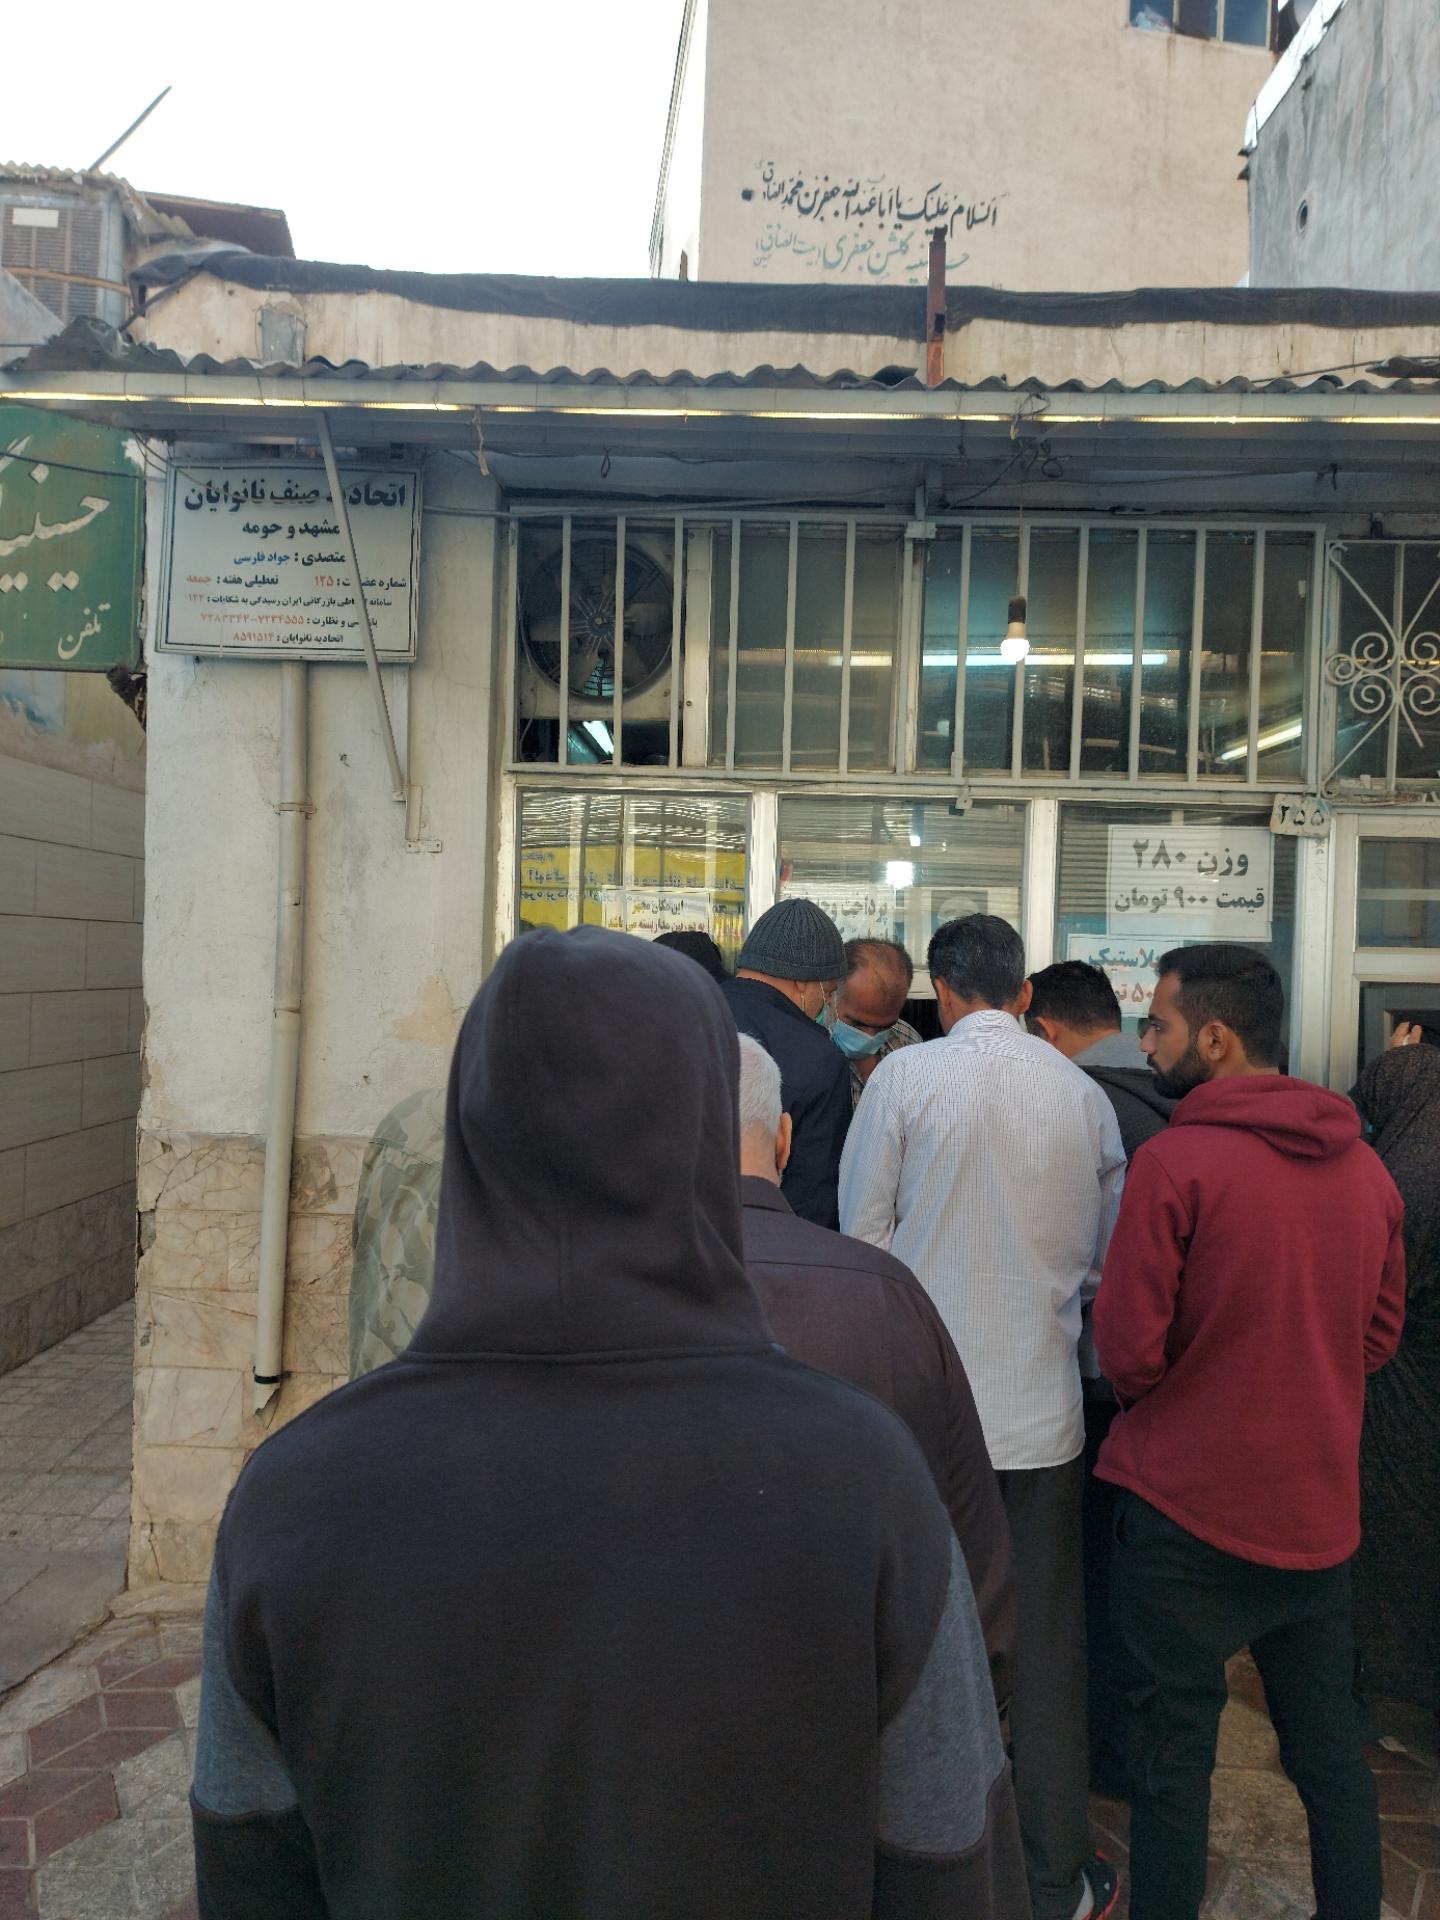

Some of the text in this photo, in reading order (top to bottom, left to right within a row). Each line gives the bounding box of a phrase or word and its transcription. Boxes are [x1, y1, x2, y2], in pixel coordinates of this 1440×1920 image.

[184, 478, 265, 513] نانوایان
[270, 480, 320, 504] صنف
[242, 519, 340, 539] مشهد و حومه
[267, 554, 290, 565] جواد
[244, 574, 279, 587] تعطیلی
[378, 577, 407, 591] شماره
[57, 603, 111, 660] تلفن
[1133, 839, 1249, 876] وزن ۲۸۰
[1114, 886, 1265, 913] قیمت ۹۰۰ تومان
